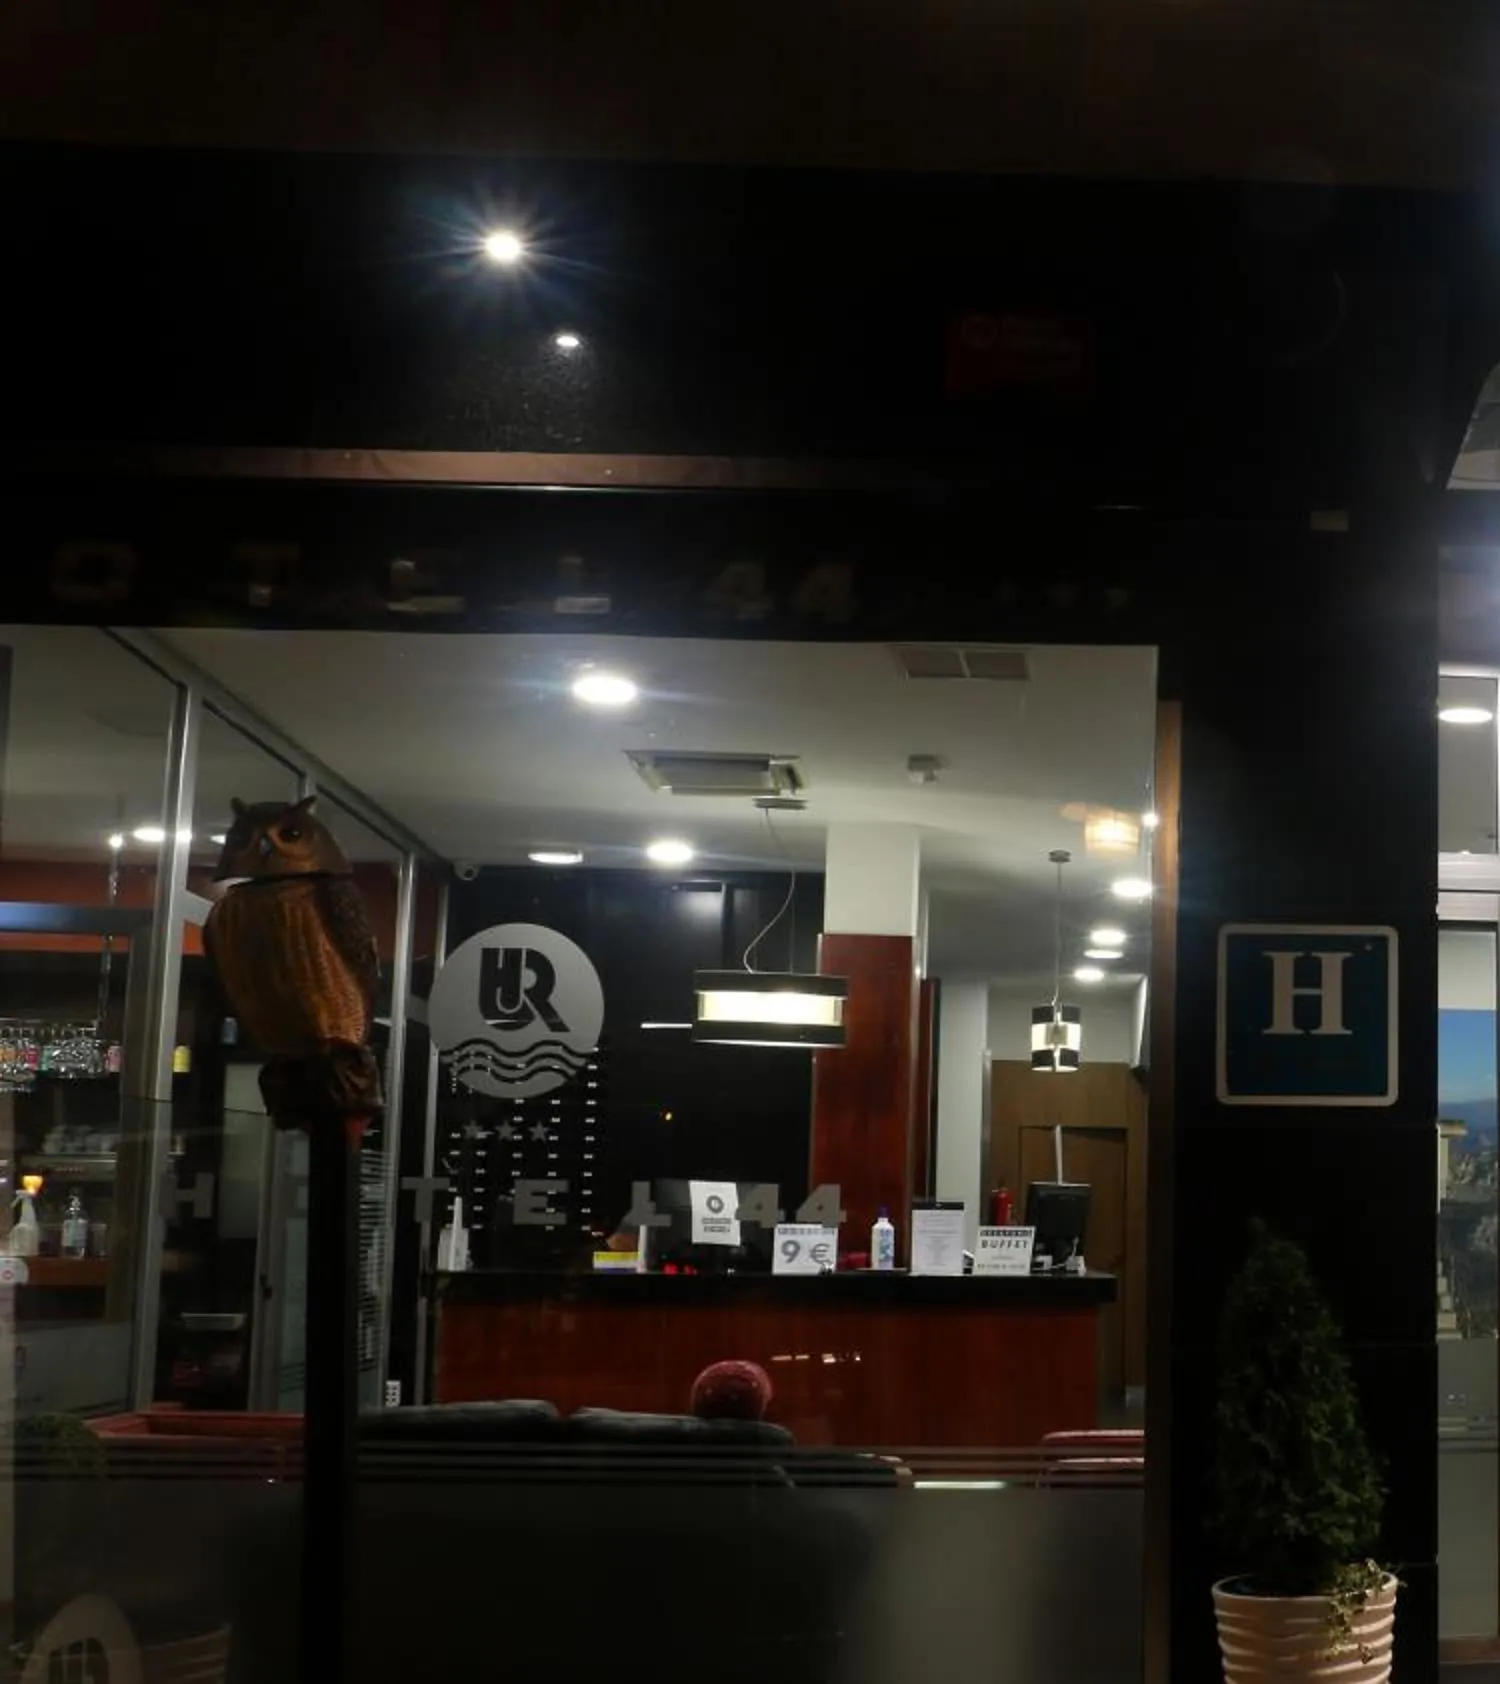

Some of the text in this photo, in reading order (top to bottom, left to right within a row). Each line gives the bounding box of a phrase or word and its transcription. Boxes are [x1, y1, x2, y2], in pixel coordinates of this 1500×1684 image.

[1262, 951, 1353, 1035] H
[737, 1182, 847, 1229] 44
[781, 1239, 801, 1264] 9
